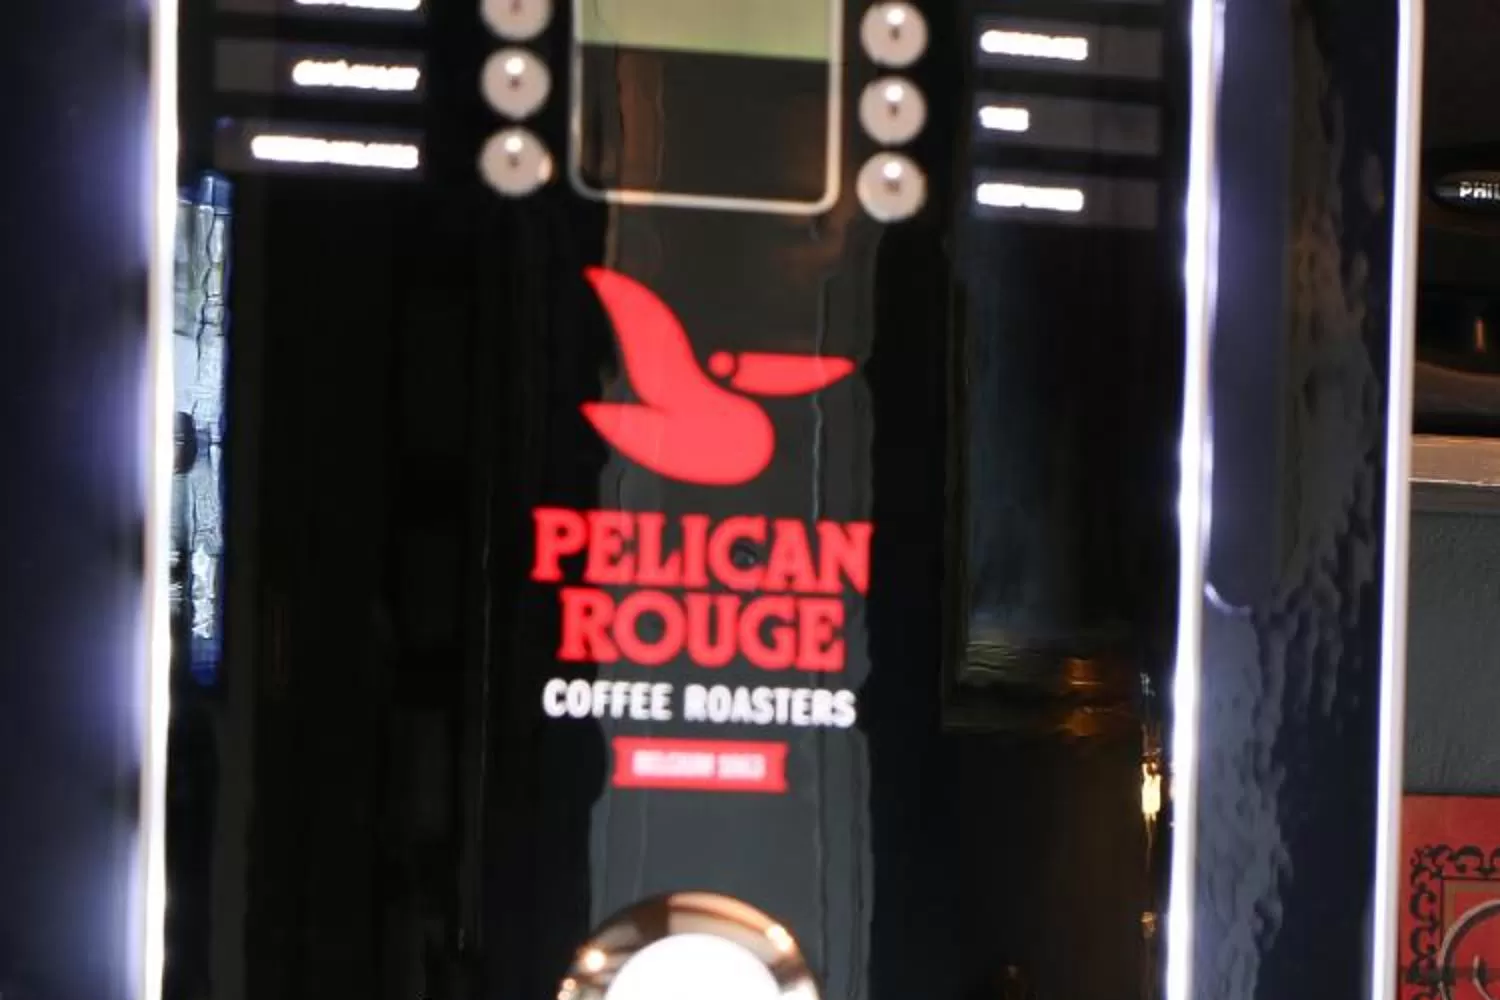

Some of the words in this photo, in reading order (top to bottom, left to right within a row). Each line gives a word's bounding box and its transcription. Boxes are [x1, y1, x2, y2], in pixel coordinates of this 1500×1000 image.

[531, 506, 873, 594] PELICAN
[556, 587, 846, 672] ROUGE
[543, 677, 673, 721] COFFEE
[683, 683, 857, 728] ROASTERS
